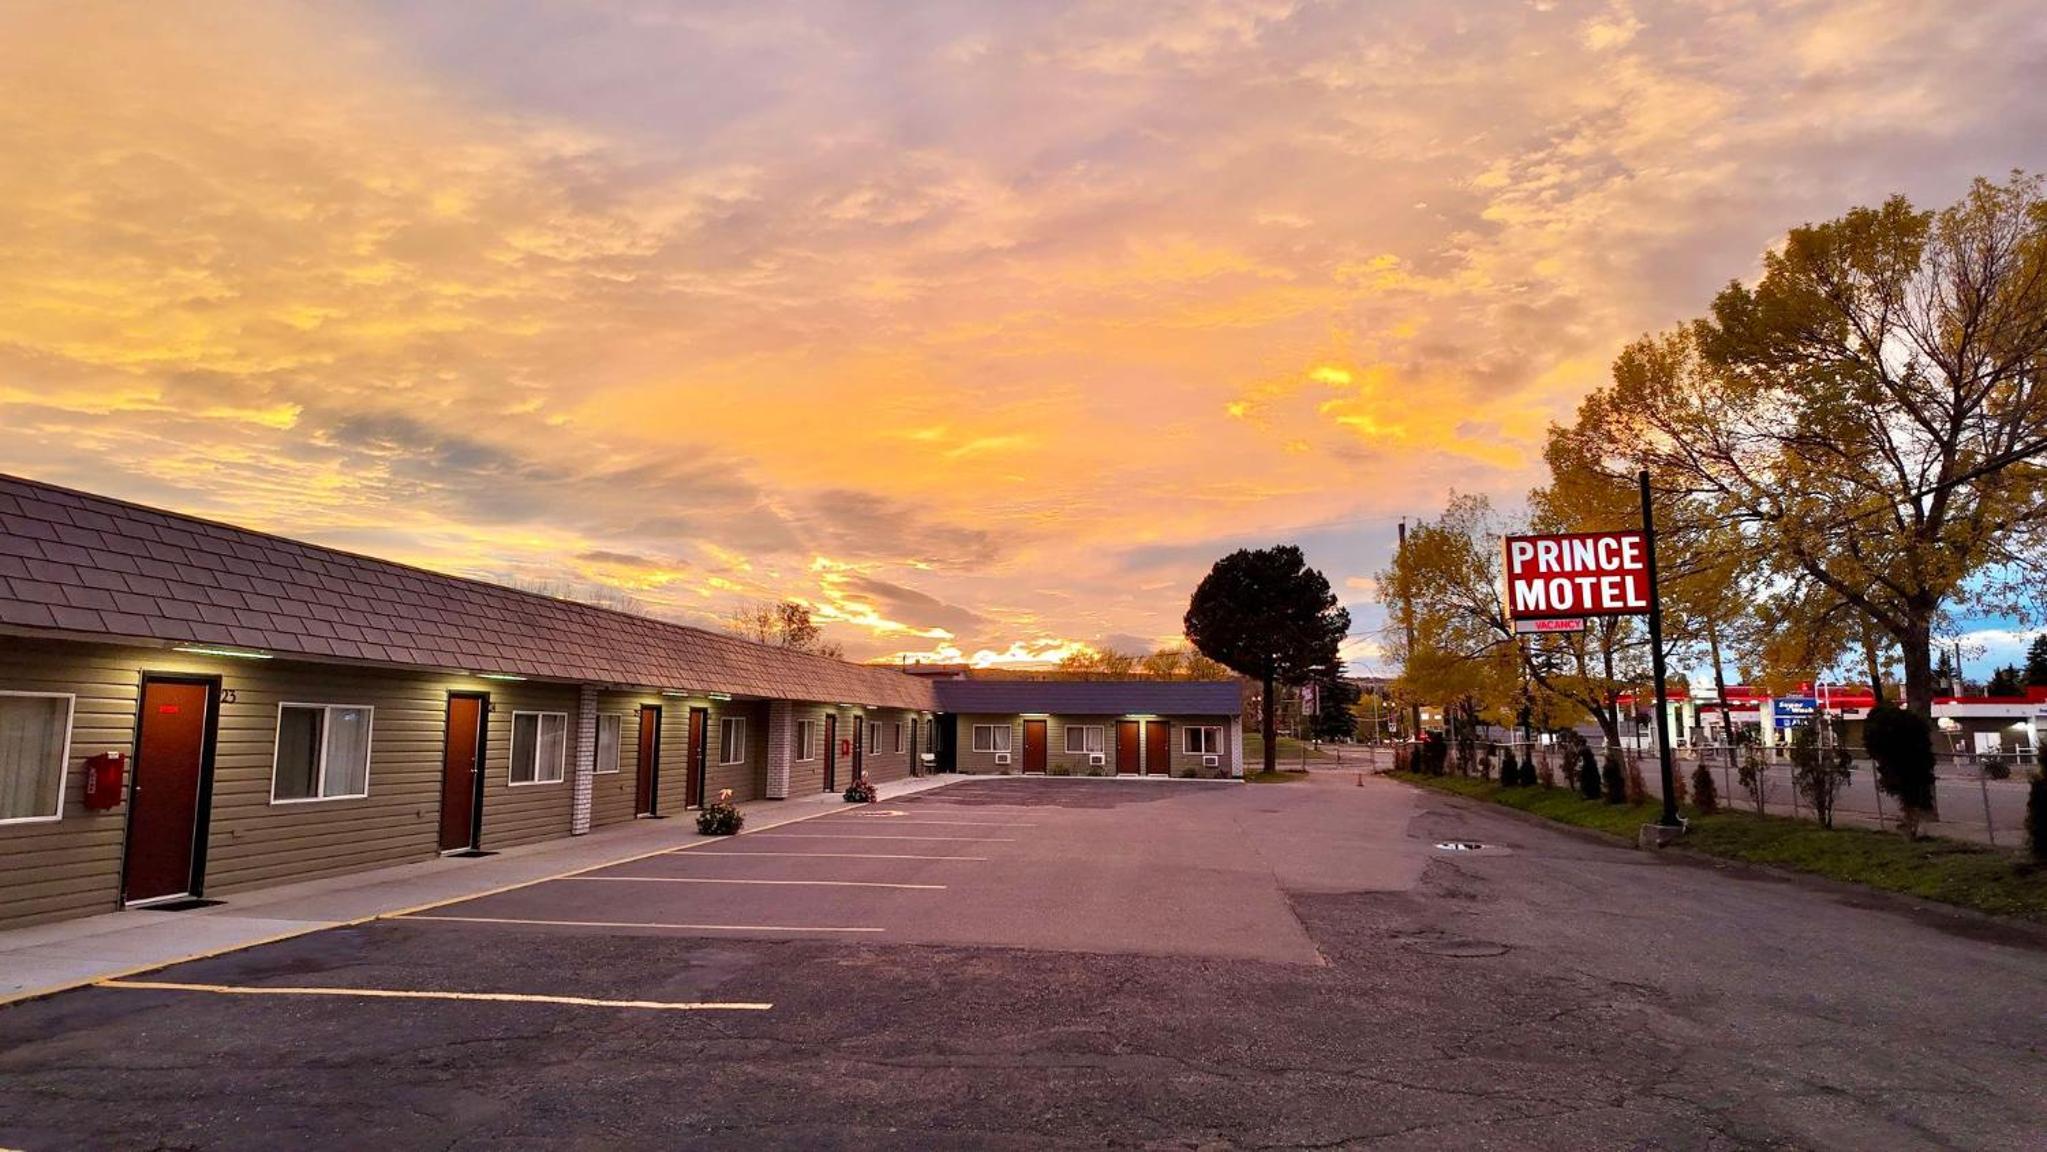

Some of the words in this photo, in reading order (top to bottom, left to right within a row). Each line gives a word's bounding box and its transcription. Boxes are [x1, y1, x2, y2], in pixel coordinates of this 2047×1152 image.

[1511, 536, 1643, 574] PRINCE
[1514, 576, 1647, 611] MOTEL
[1535, 620, 1581, 630] VACANCY
[221, 688, 236, 704] 23
